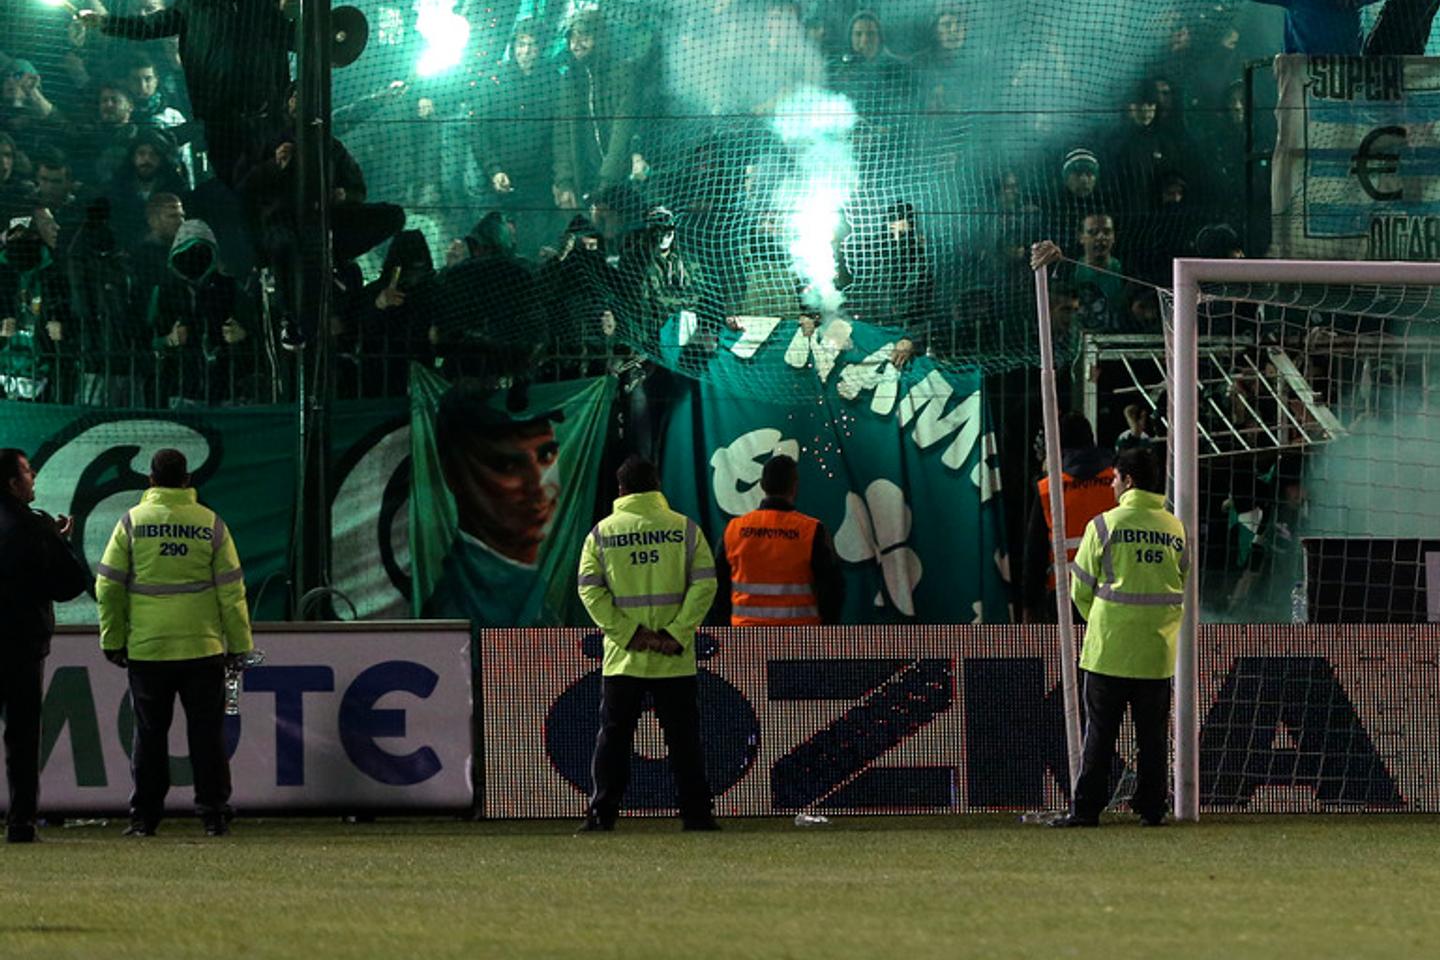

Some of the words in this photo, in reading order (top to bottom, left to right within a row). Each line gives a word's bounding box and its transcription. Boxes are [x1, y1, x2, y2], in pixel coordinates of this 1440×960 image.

[1311, 55, 1401, 100] SUPER
[147, 524, 213, 540] BRINKS
[616, 530, 684, 547] BRINKS
[1122, 529, 1183, 552] BRINKS
[160, 543, 188, 556] 290
[630, 550, 659, 565] 195
[1136, 549, 1163, 564] 165
